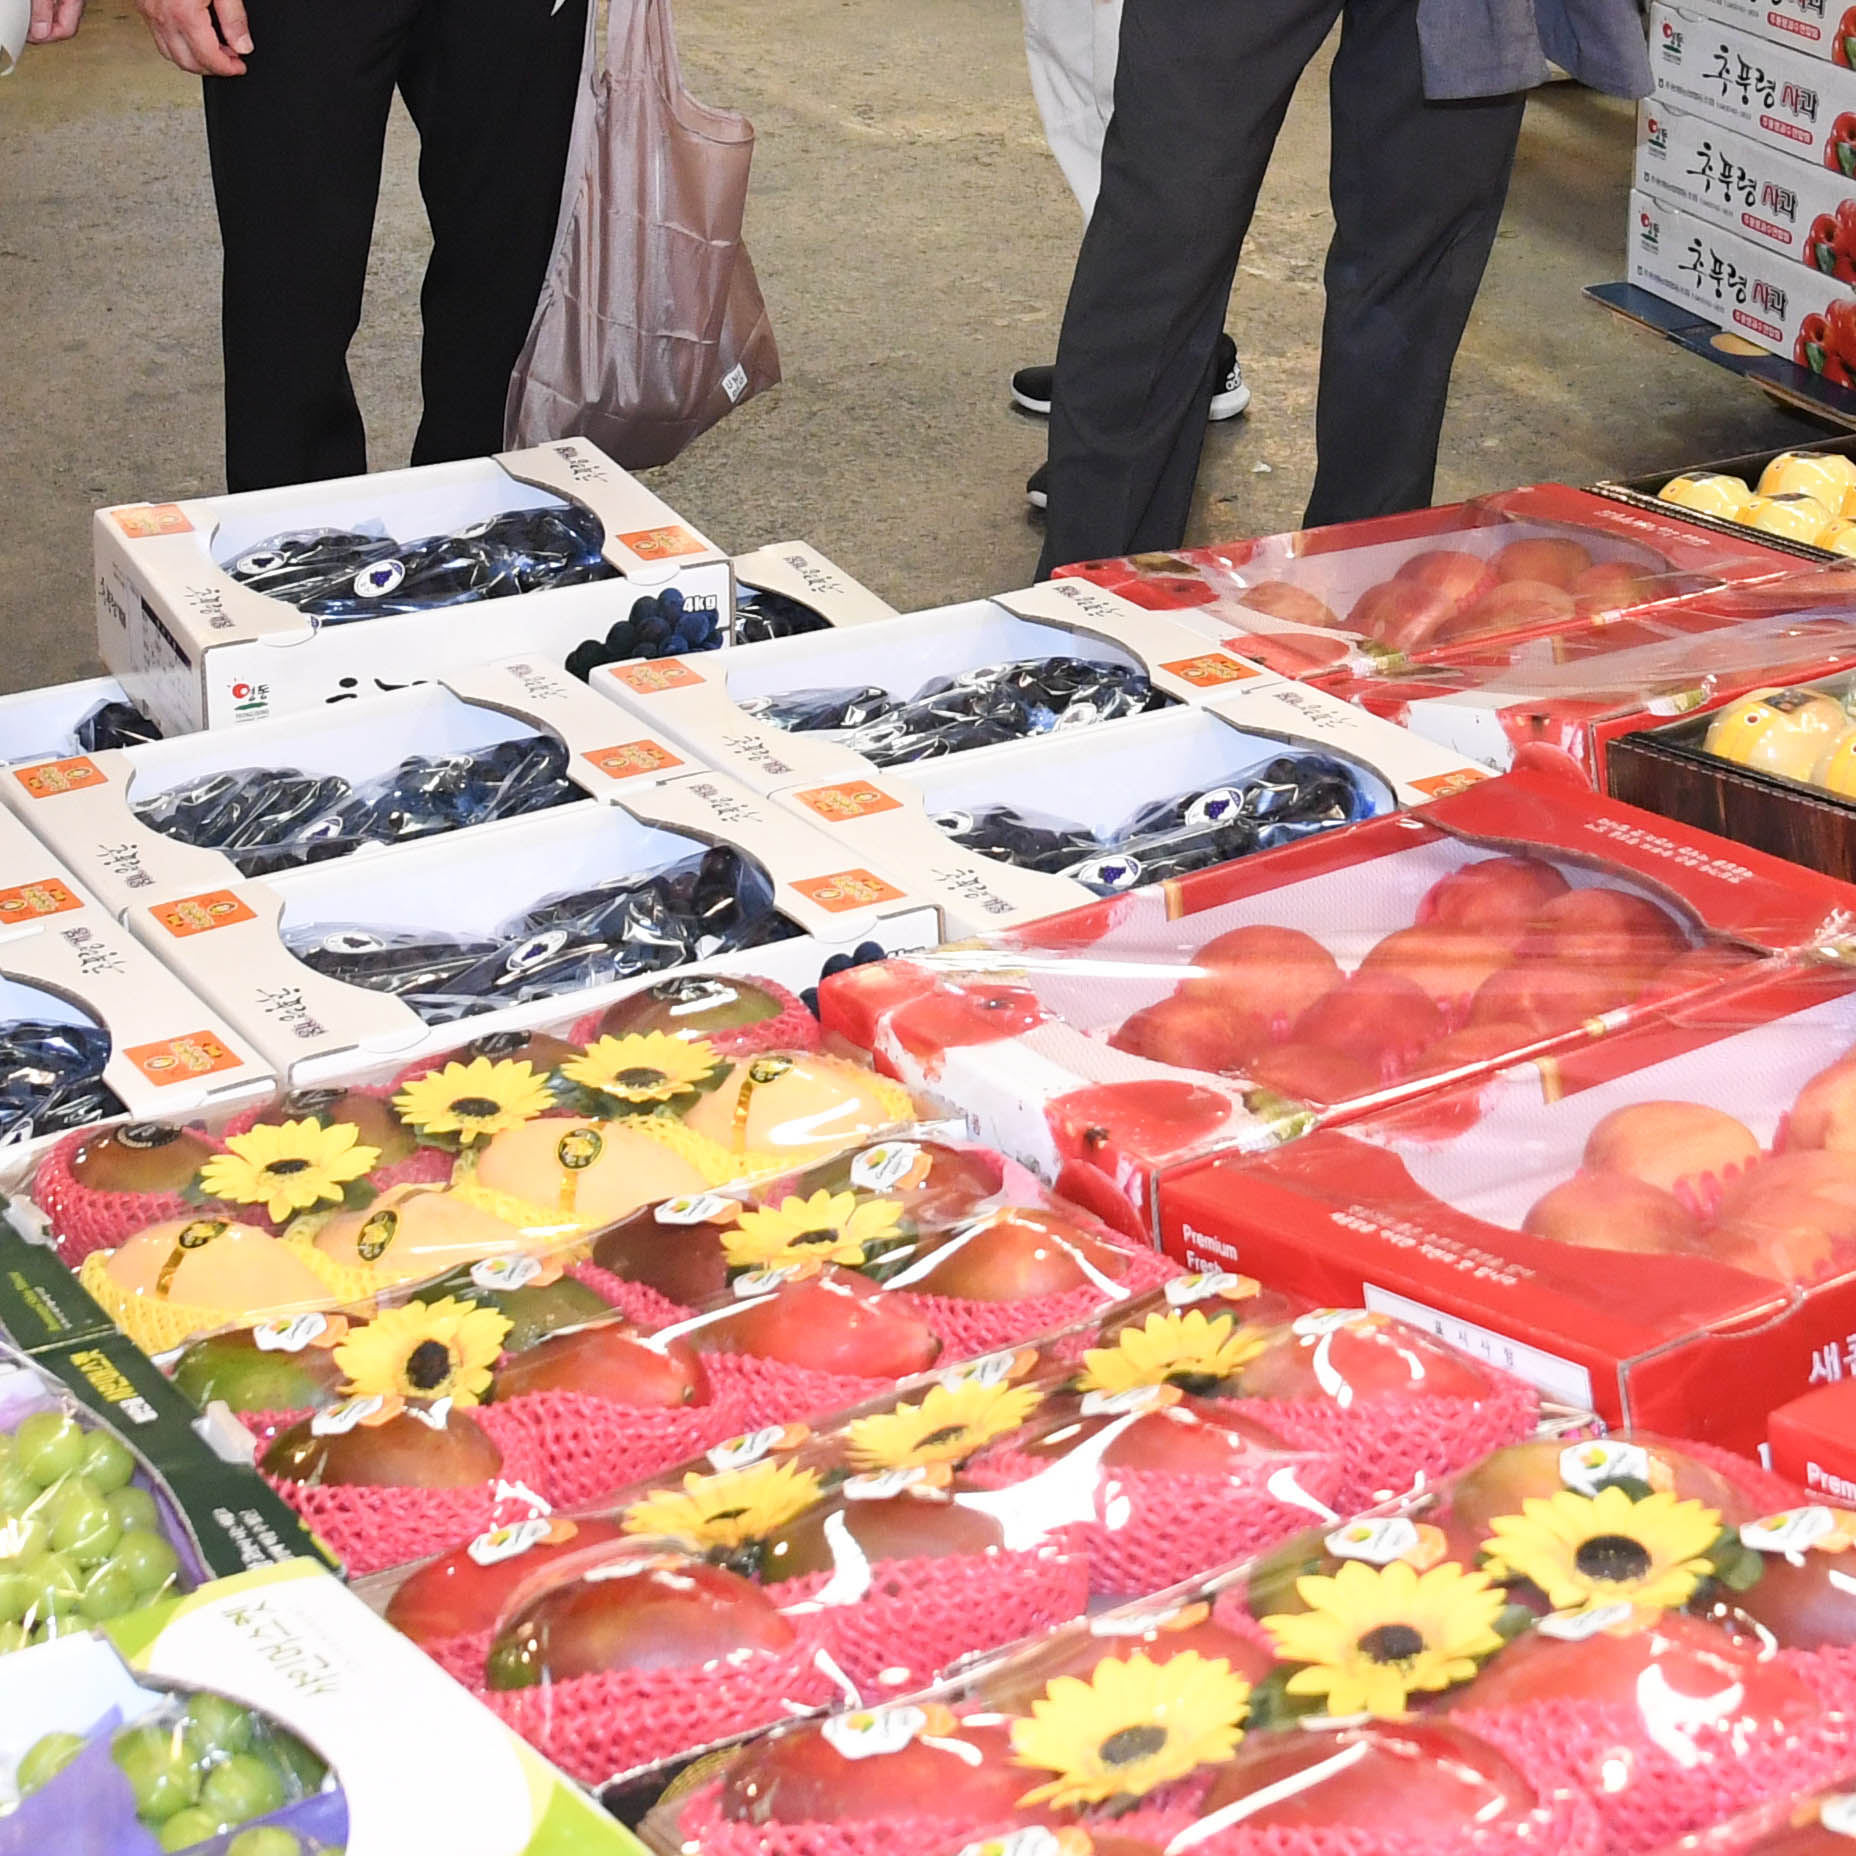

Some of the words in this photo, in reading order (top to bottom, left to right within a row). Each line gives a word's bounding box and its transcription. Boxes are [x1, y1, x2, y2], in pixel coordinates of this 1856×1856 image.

[1702, 45, 1777, 109] 추풍령
[1780, 84, 1819, 123] 사과
[1686, 141, 1758, 208] 추풍령
[1761, 181, 1798, 222] 사과
[1678, 238, 1748, 304] 추풍령
[1751, 279, 1789, 322] 사과
[683, 595, 717, 614] 4kg
[1181, 1222, 1241, 1264] Premium
